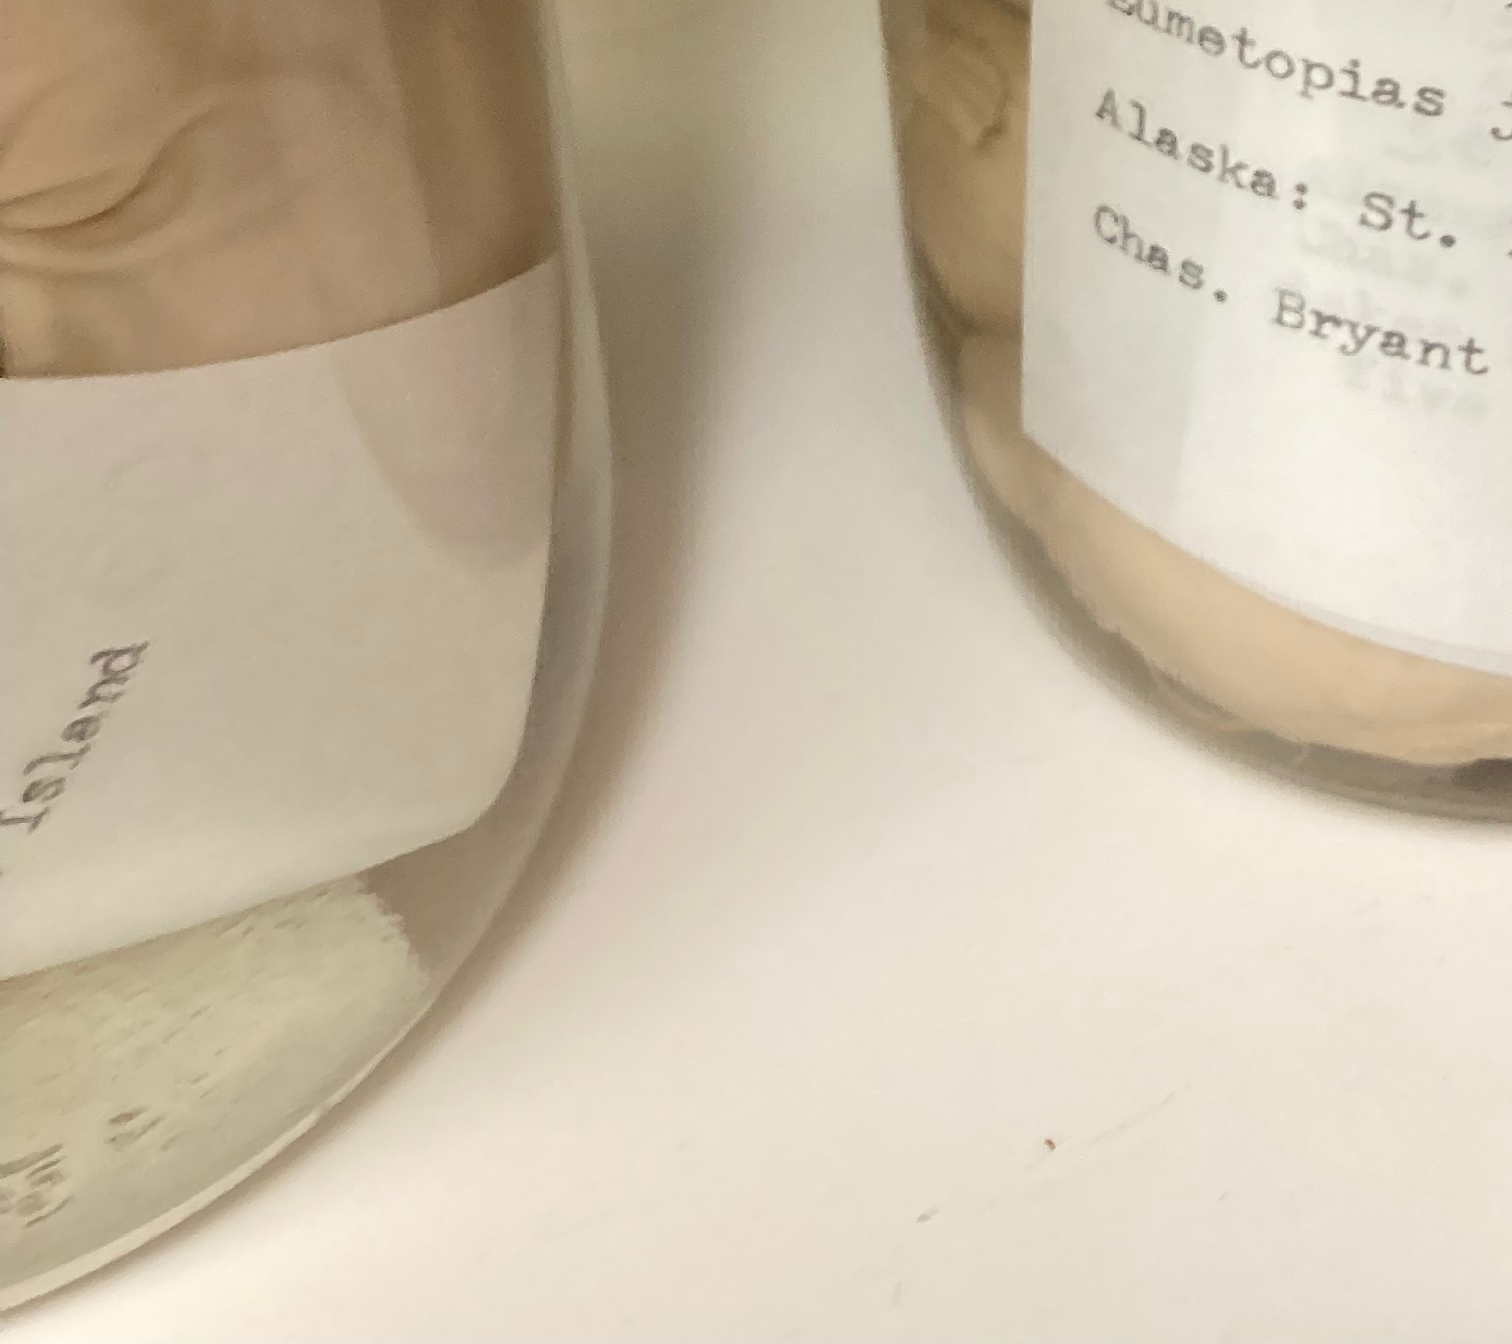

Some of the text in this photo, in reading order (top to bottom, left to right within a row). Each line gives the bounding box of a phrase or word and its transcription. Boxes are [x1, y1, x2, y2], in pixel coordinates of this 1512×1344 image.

[1095, 88, 1310, 211] Alaska:
[1359, 190, 1458, 250] St.
[1093, 203, 1491, 376] Chas. Bryant
